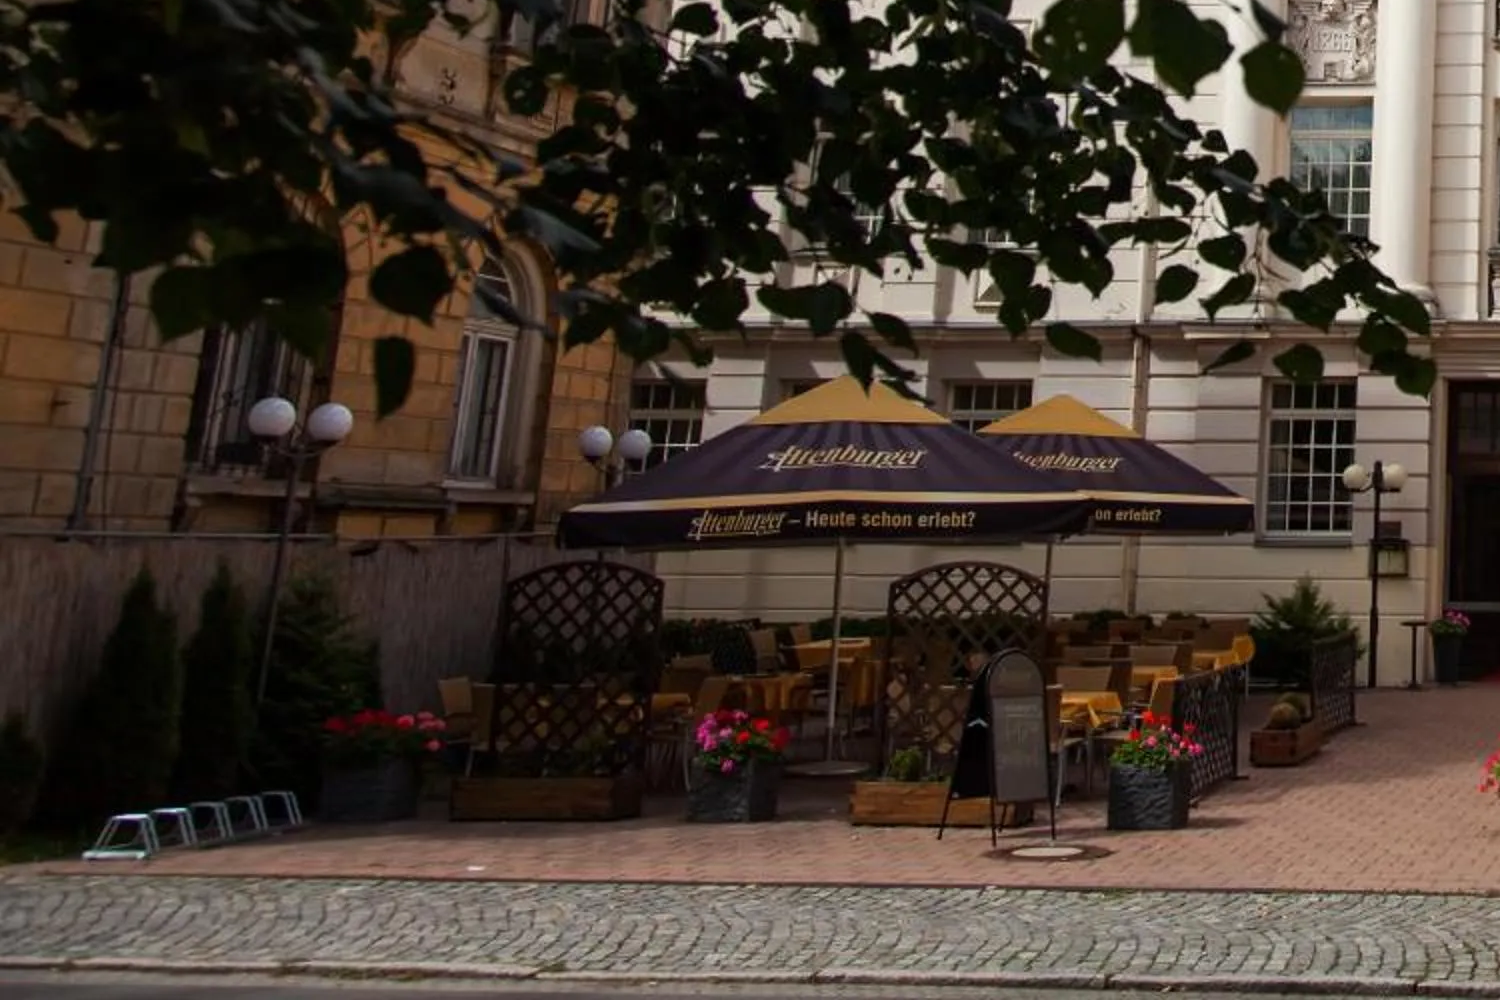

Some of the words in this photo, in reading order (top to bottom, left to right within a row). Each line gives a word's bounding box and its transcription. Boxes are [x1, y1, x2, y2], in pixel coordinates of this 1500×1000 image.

[758, 444, 929, 472] Altenburger
[686, 510, 789, 542] Altenburger
[805, 510, 856, 528] Heute
[861, 511, 913, 528] schon
[917, 511, 977, 529] erlebt?
